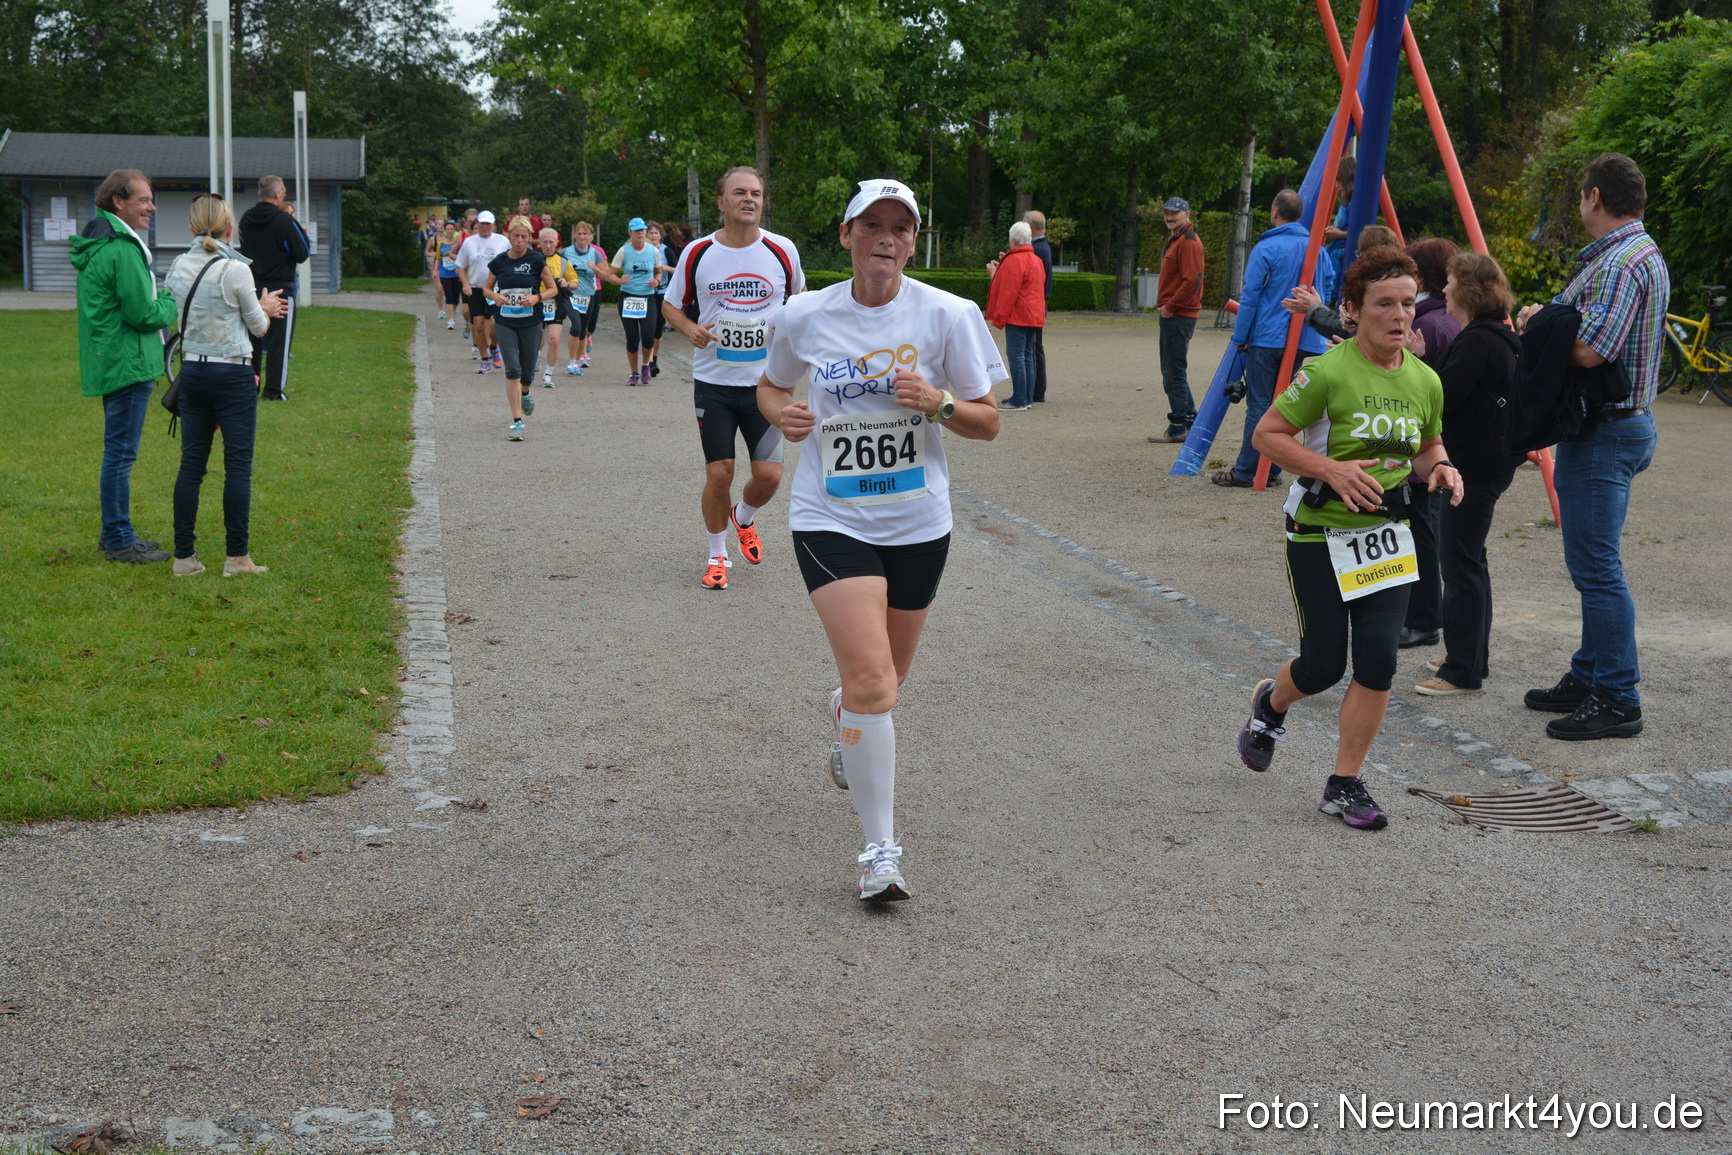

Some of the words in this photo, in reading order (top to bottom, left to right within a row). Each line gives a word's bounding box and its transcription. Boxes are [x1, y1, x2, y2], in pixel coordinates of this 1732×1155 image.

[708, 281, 760, 290] GERHART
[505, 294, 527, 306] 284
[626, 302, 645, 310] 2703
[720, 328, 764, 349] 3358
[814, 356, 869, 383] NEW
[1364, 393, 1410, 414] FÜRTH
[822, 423, 857, 433] PARTL
[859, 418, 908, 431] Neumarkt
[833, 430, 917, 471] 2664
[859, 477, 896, 494] Birgit
[1346, 527, 1399, 565] 180
[1356, 563, 1404, 585] Christine
